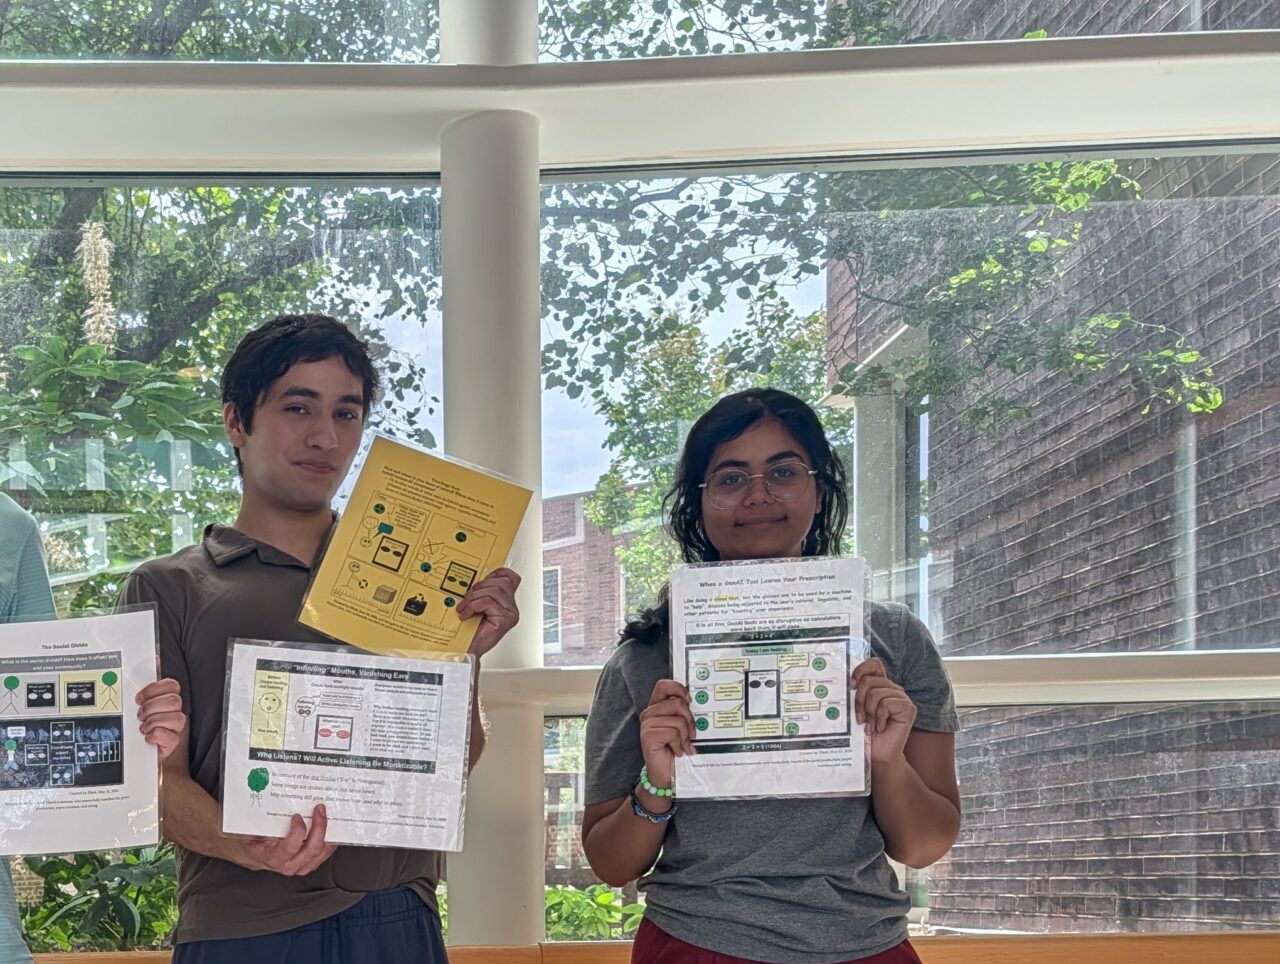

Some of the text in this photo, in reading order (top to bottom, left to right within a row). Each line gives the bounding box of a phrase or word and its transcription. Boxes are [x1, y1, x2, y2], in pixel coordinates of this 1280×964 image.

[798, 574, 835, 583] Prescription
[330, 666, 358, 676] Mouths,
[358, 668, 392, 679] Vanishing
[392, 671, 409, 680] Ears
[256, 751, 272, 759] Who
[272, 752, 301, 761] Listens?
[302, 754, 316, 762] Will
[316, 755, 338, 764] Active
[339, 757, 371, 766] Listening
[382, 760, 427, 771] Monetizable?
